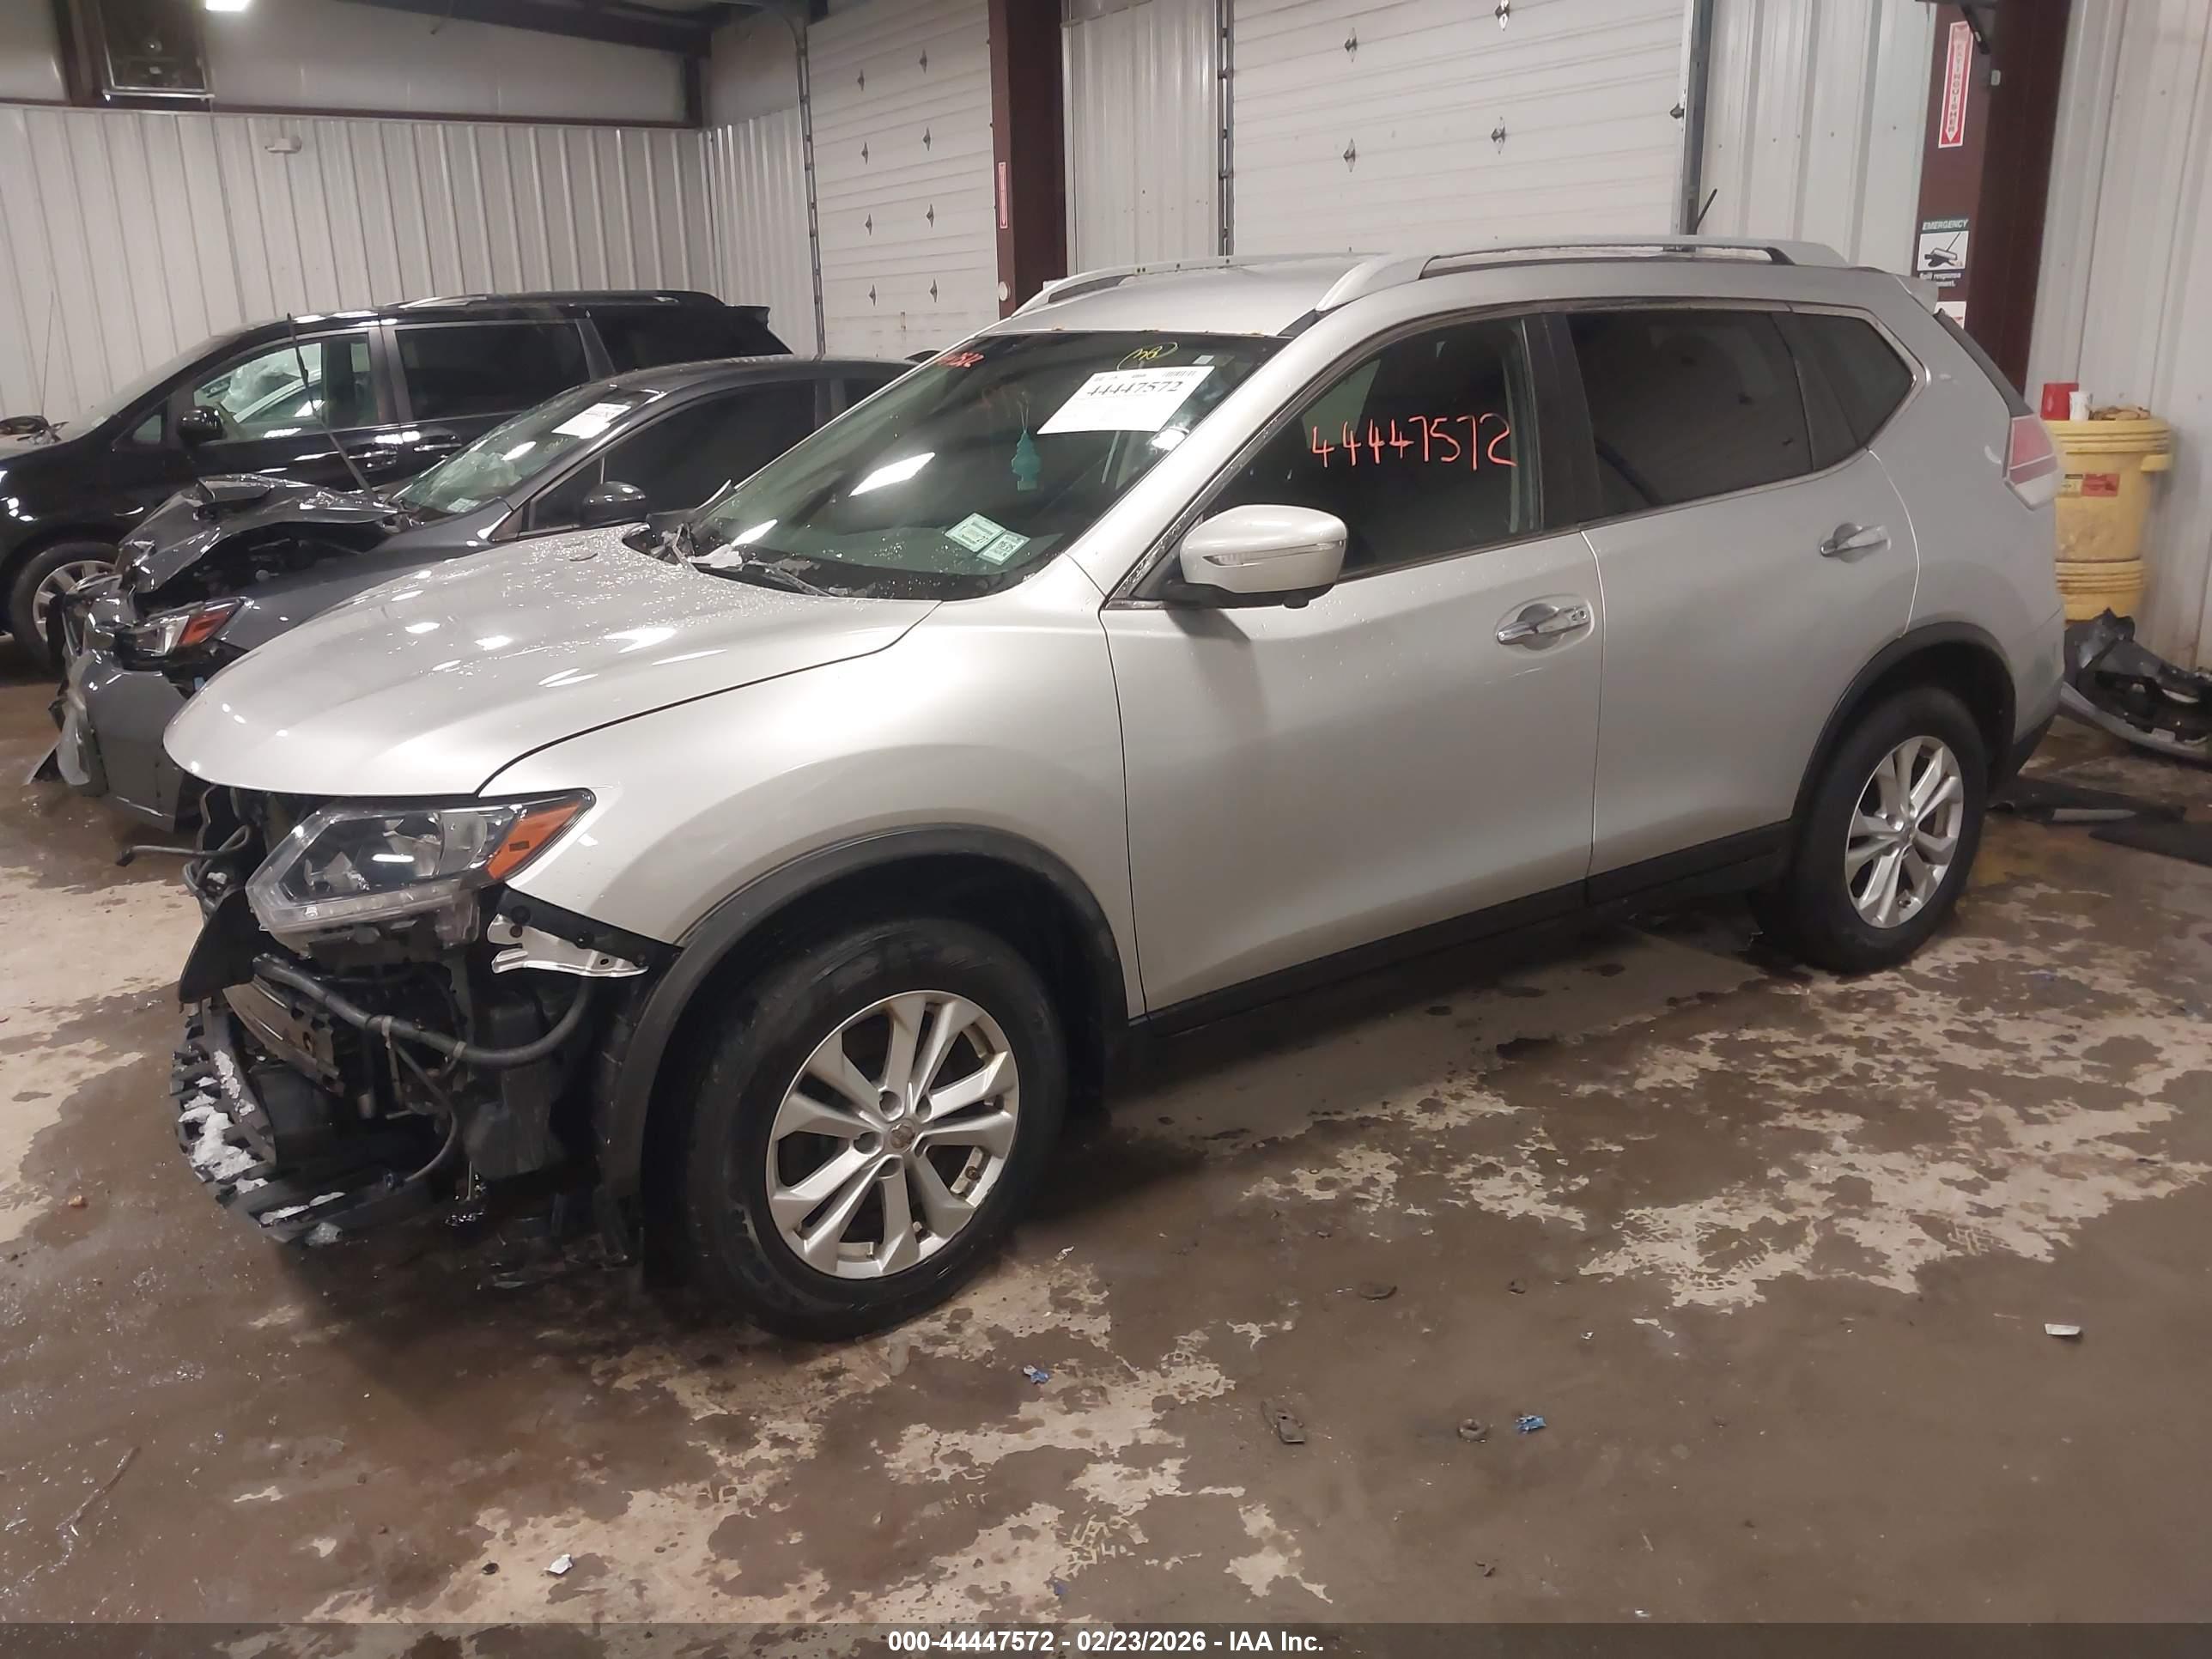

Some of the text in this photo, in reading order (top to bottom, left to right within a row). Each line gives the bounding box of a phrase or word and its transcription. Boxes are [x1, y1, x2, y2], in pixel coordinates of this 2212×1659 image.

[1922, 219, 1969, 231] EMERGENCY
[1087, 381, 1183, 396] 44447572
[1311, 412, 1517, 471] 44447572
